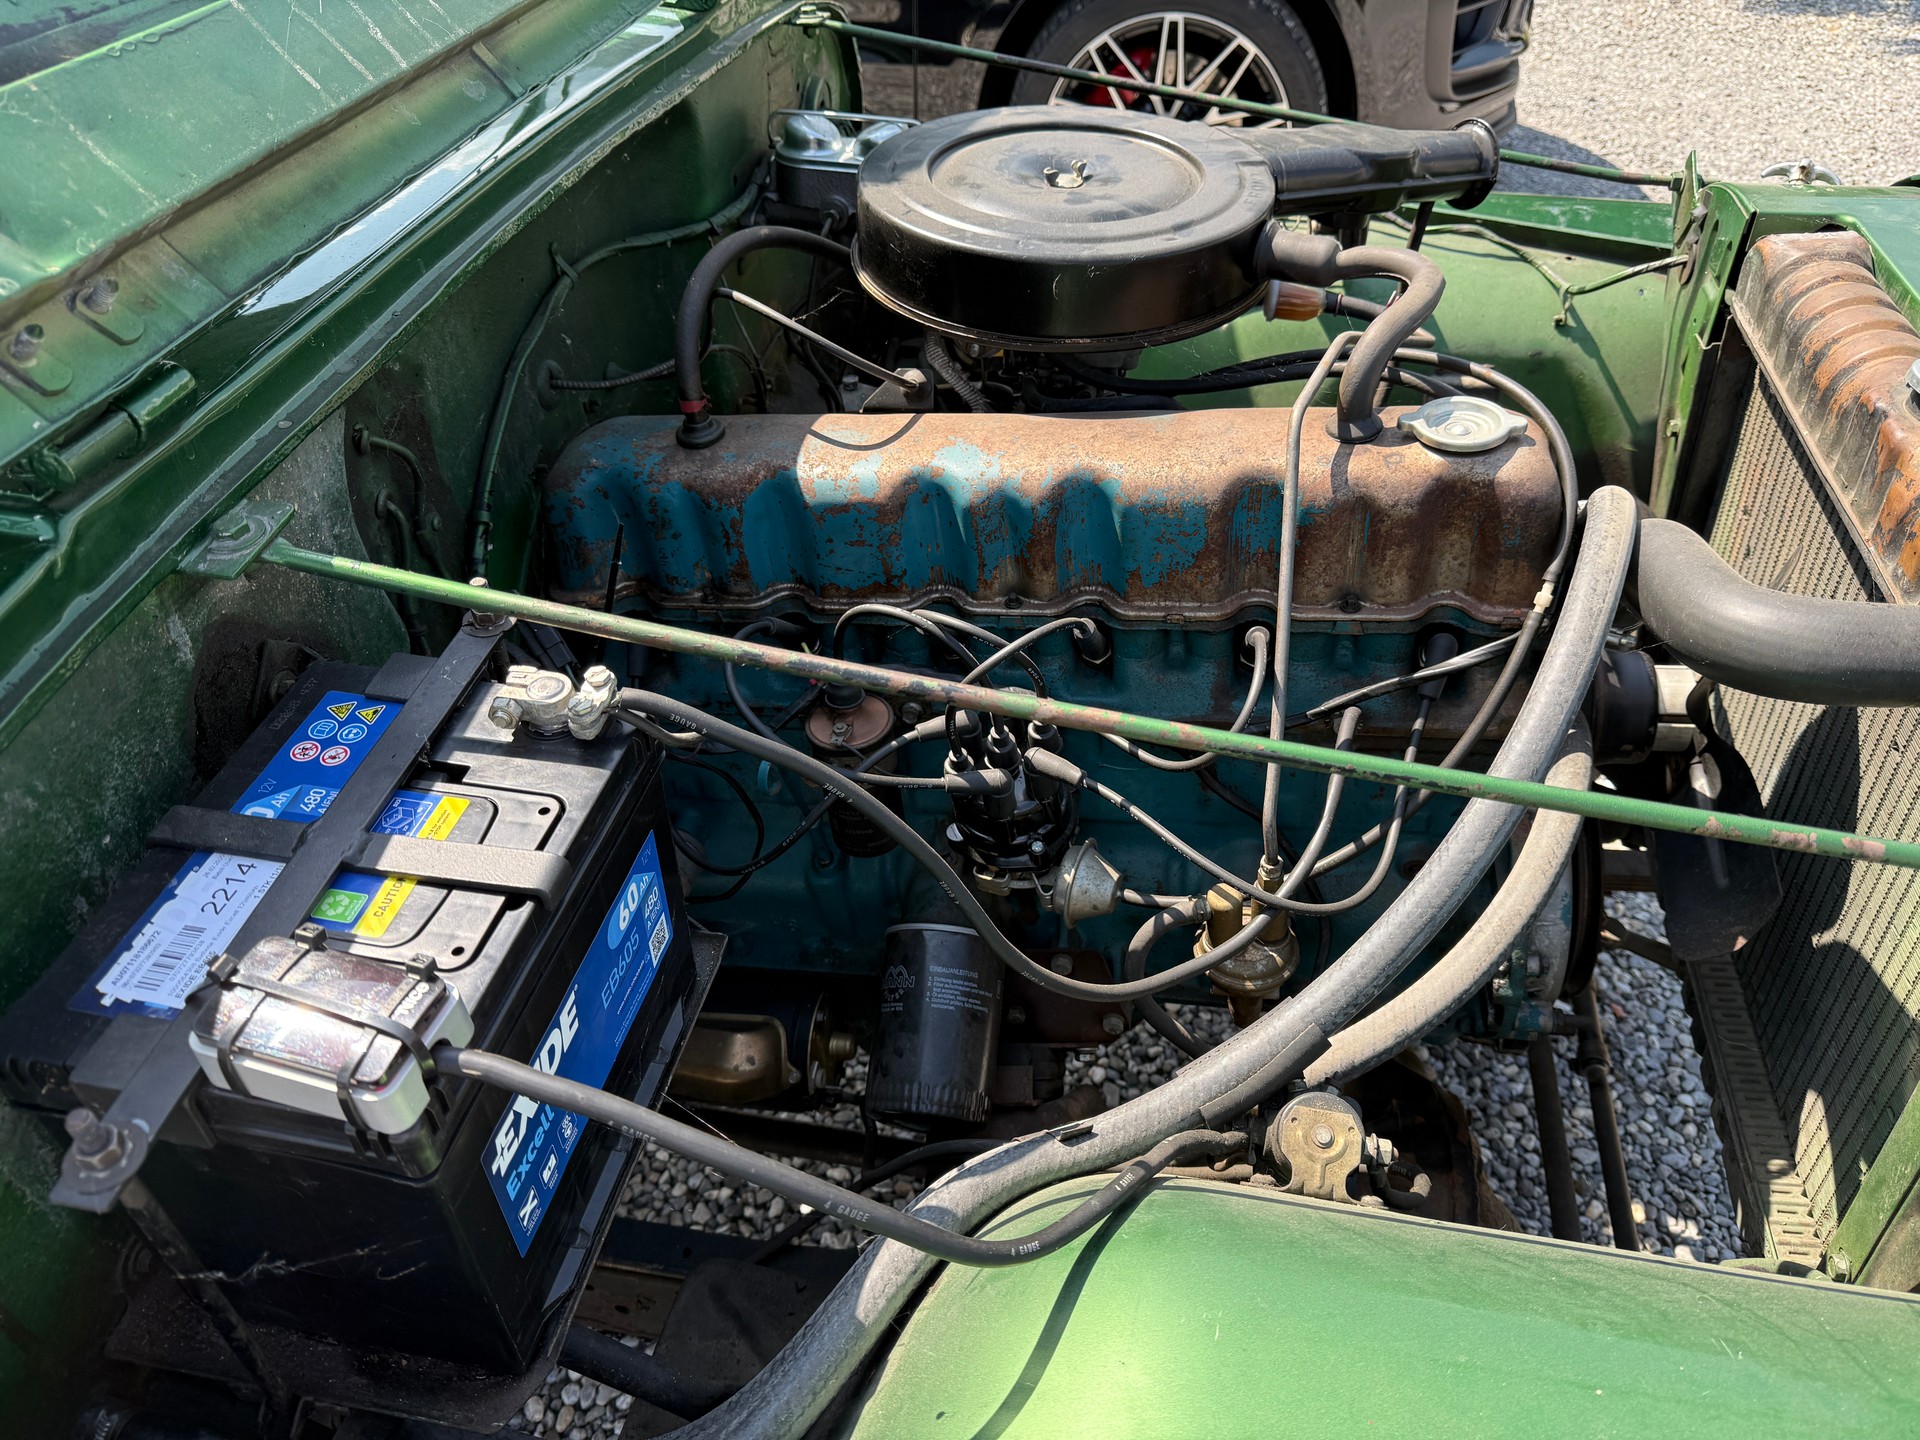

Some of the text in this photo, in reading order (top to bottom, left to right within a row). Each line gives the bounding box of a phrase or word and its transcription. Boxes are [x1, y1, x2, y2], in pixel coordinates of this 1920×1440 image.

[670, 713, 697, 730] GAUGE
[258, 778, 277, 793] 12V
[822, 782, 845, 798] GAUGE
[271, 792, 290, 808] Ah
[300, 788, 326, 812] 480
[641, 843, 652, 866] 12V
[200, 863, 257, 916] 2214
[619, 875, 649, 931] 60 Ah
[645, 886, 658, 919] 480
[601, 926, 640, 1010] EB605
[175, 974, 197, 998] EXIDE
[505, 1103, 556, 1201] Excell
[837, 1205, 870, 1222] GAUGE
[1019, 1240, 1040, 1255] GAUGE
